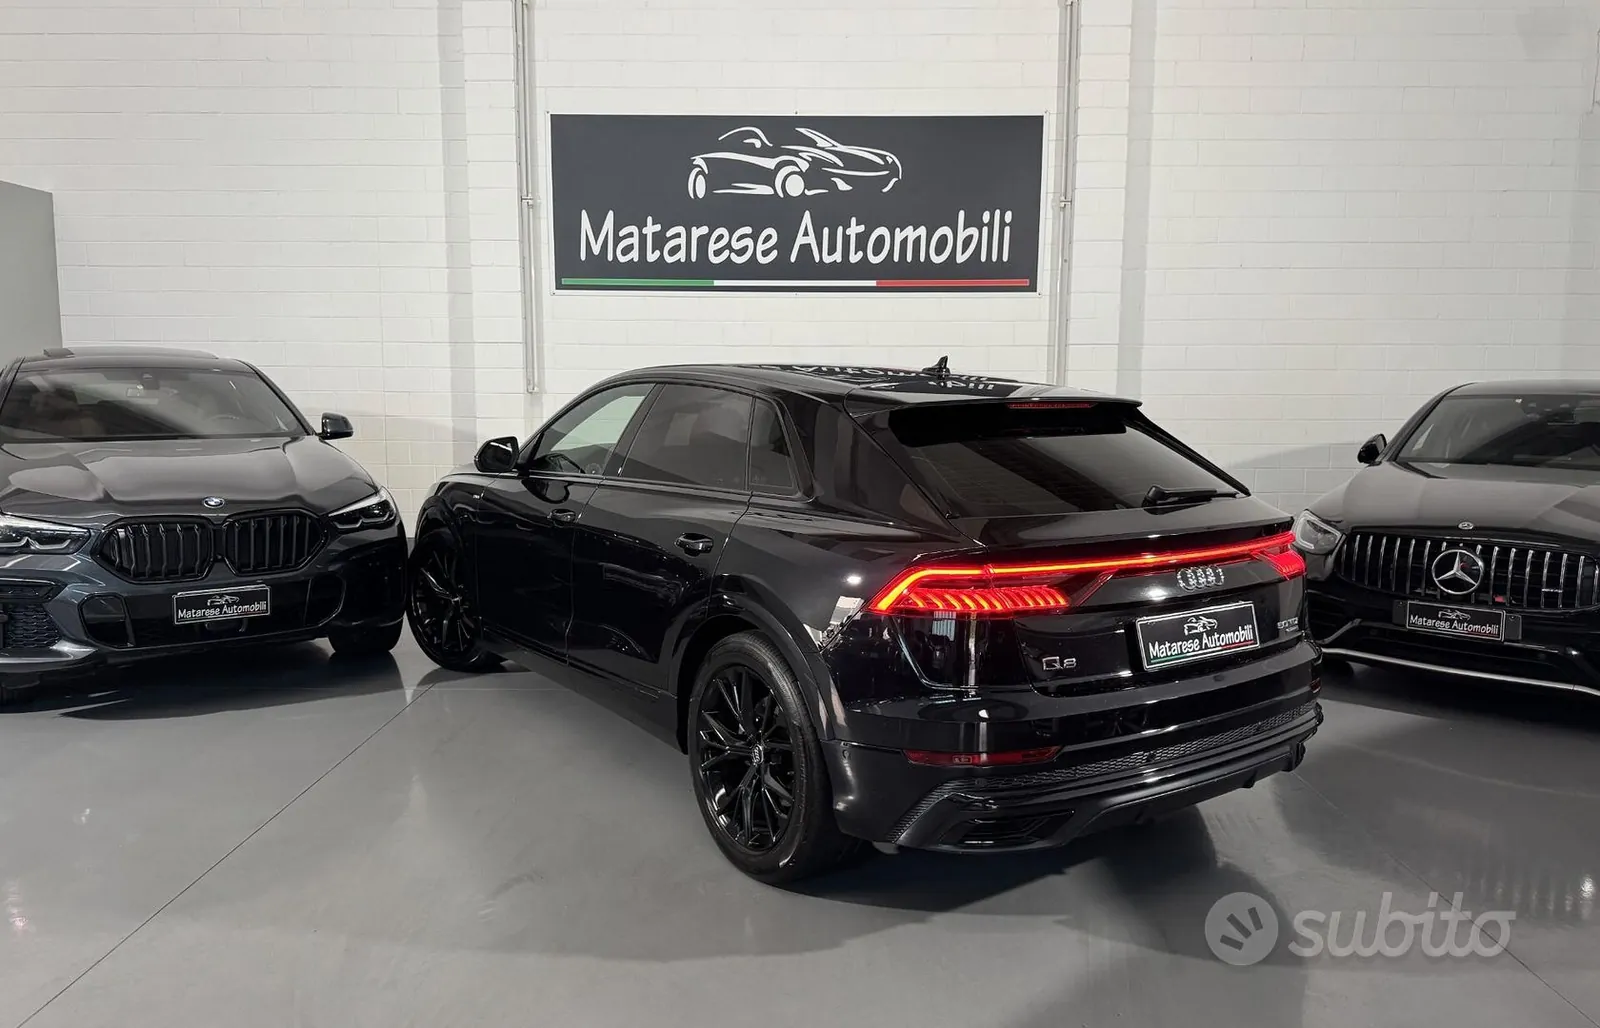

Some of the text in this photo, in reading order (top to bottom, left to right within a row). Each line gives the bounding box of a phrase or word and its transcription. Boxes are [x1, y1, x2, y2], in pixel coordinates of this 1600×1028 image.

[580, 209, 1013, 264] Matarese Automobili
[178, 601, 267, 619] Matarese Automobili
[1409, 614, 1499, 635] Matarese Automobili
[1148, 624, 1254, 659] Matarese Automobili
[1042, 656, 1076, 670] Q8
